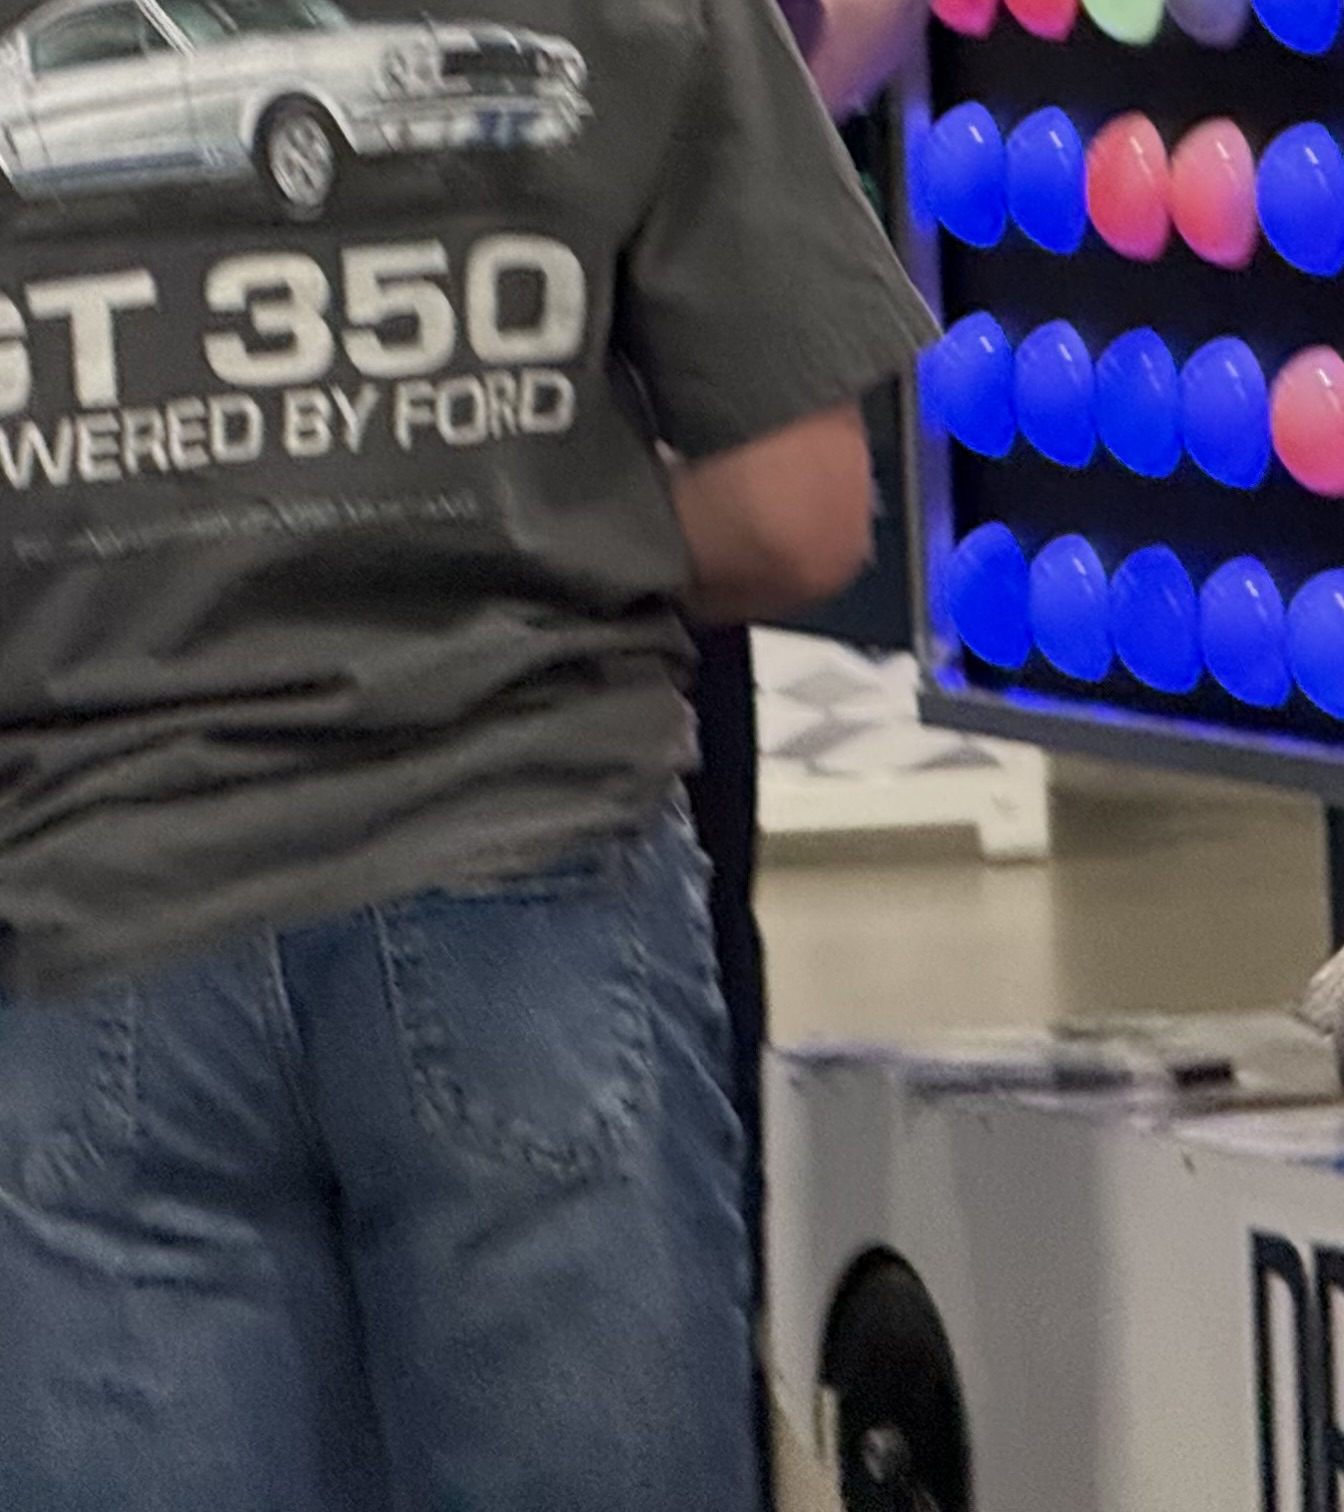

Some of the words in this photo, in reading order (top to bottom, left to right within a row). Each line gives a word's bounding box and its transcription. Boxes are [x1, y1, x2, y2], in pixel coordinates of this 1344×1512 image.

[203, 233, 587, 387] 350
[282, 384, 379, 458] BY
[392, 369, 575, 450] FORD
